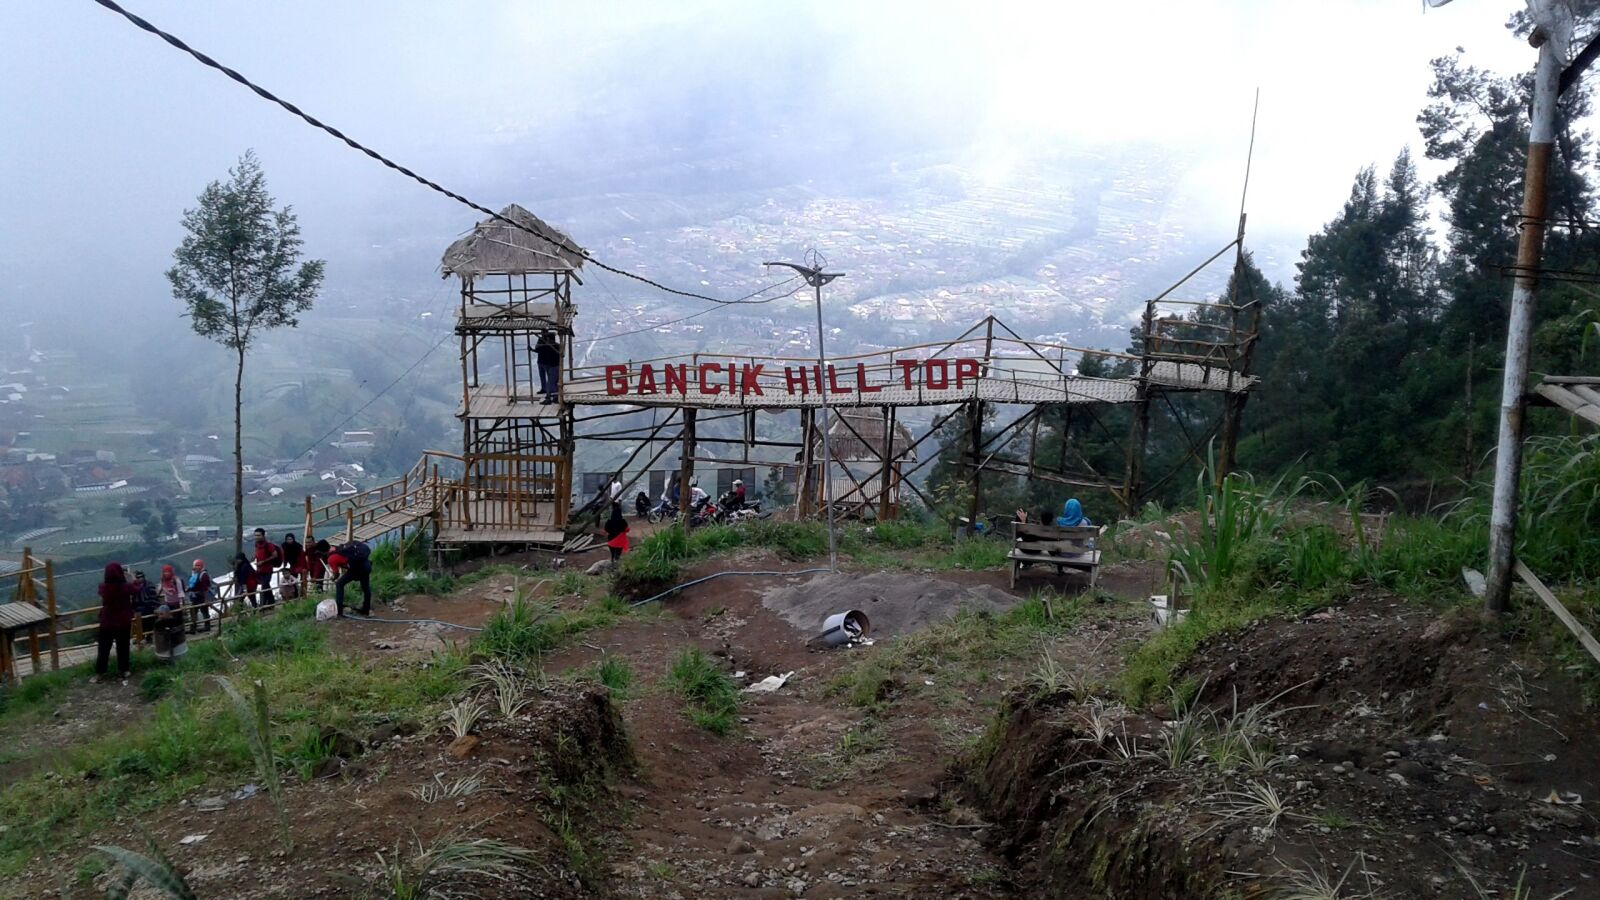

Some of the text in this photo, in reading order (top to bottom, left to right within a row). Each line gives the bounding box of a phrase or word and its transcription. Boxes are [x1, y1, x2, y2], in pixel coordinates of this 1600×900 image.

[605, 358, 980, 396] GANCIK HILL TOP
